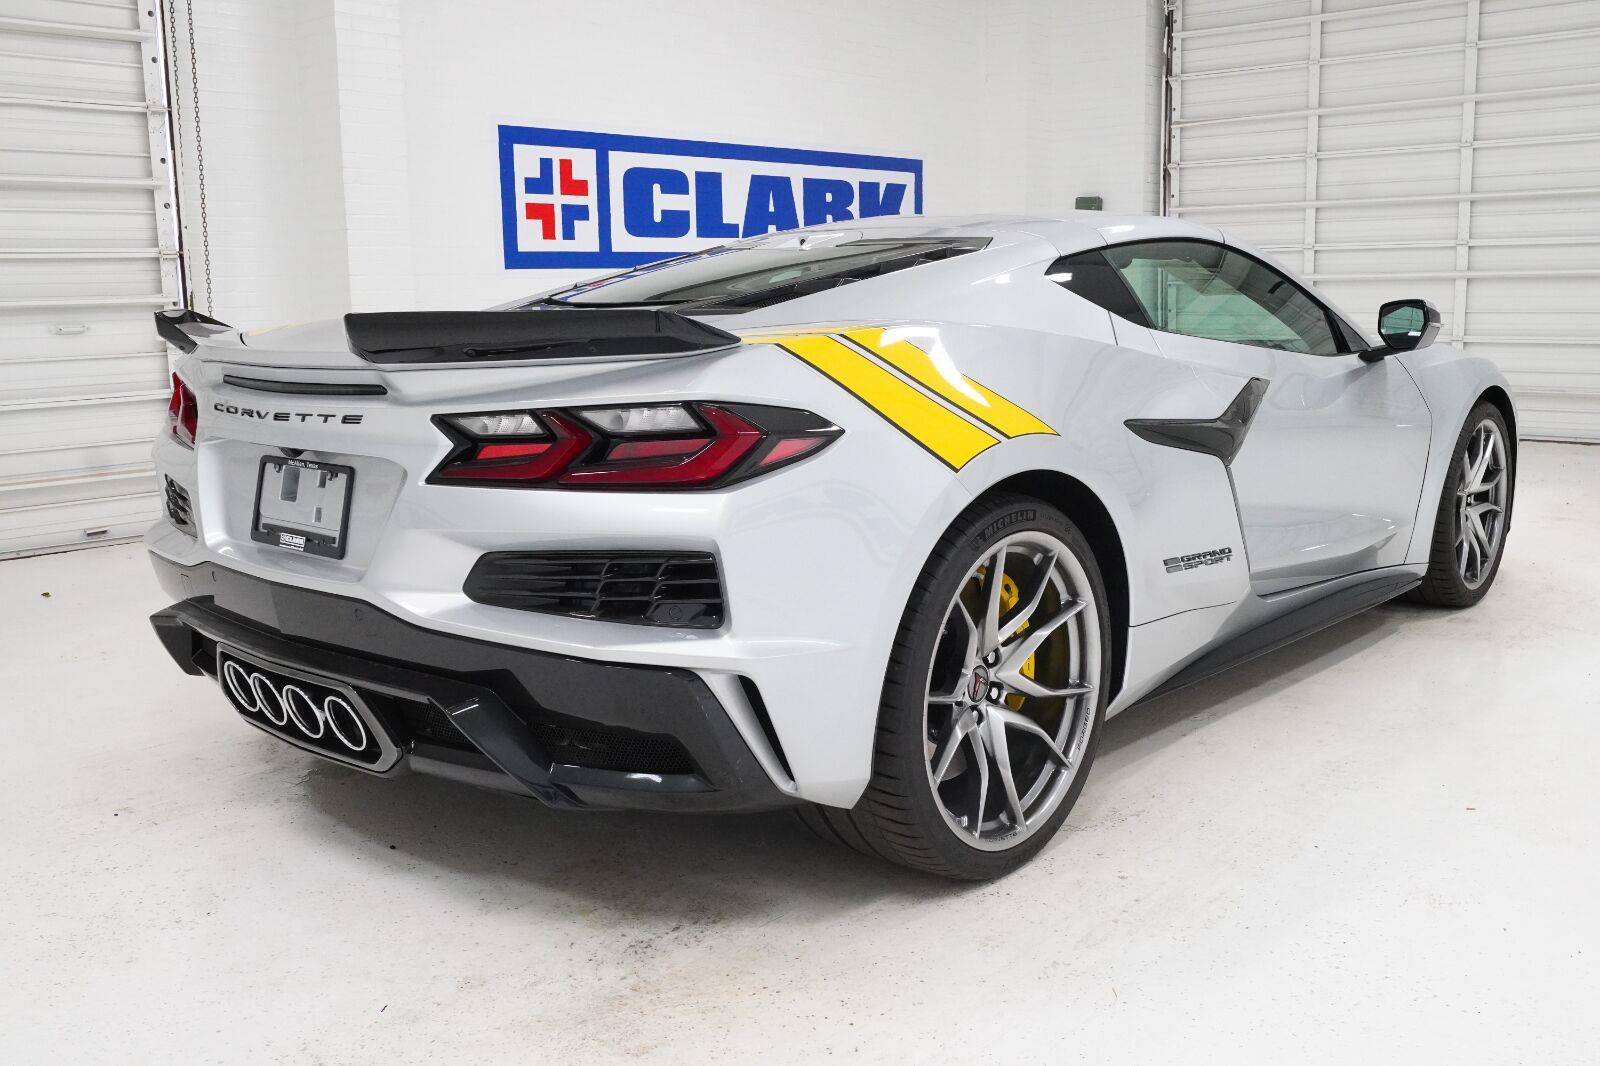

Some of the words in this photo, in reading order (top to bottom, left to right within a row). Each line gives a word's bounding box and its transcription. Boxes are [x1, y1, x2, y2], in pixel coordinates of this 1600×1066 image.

[623, 167, 907, 239] CLARK
[213, 402, 364, 425] CORVETTE
[984, 509, 1036, 538] MICHELIN
[1180, 547, 1232, 563] GRAND
[1183, 554, 1233, 570] SPORT
